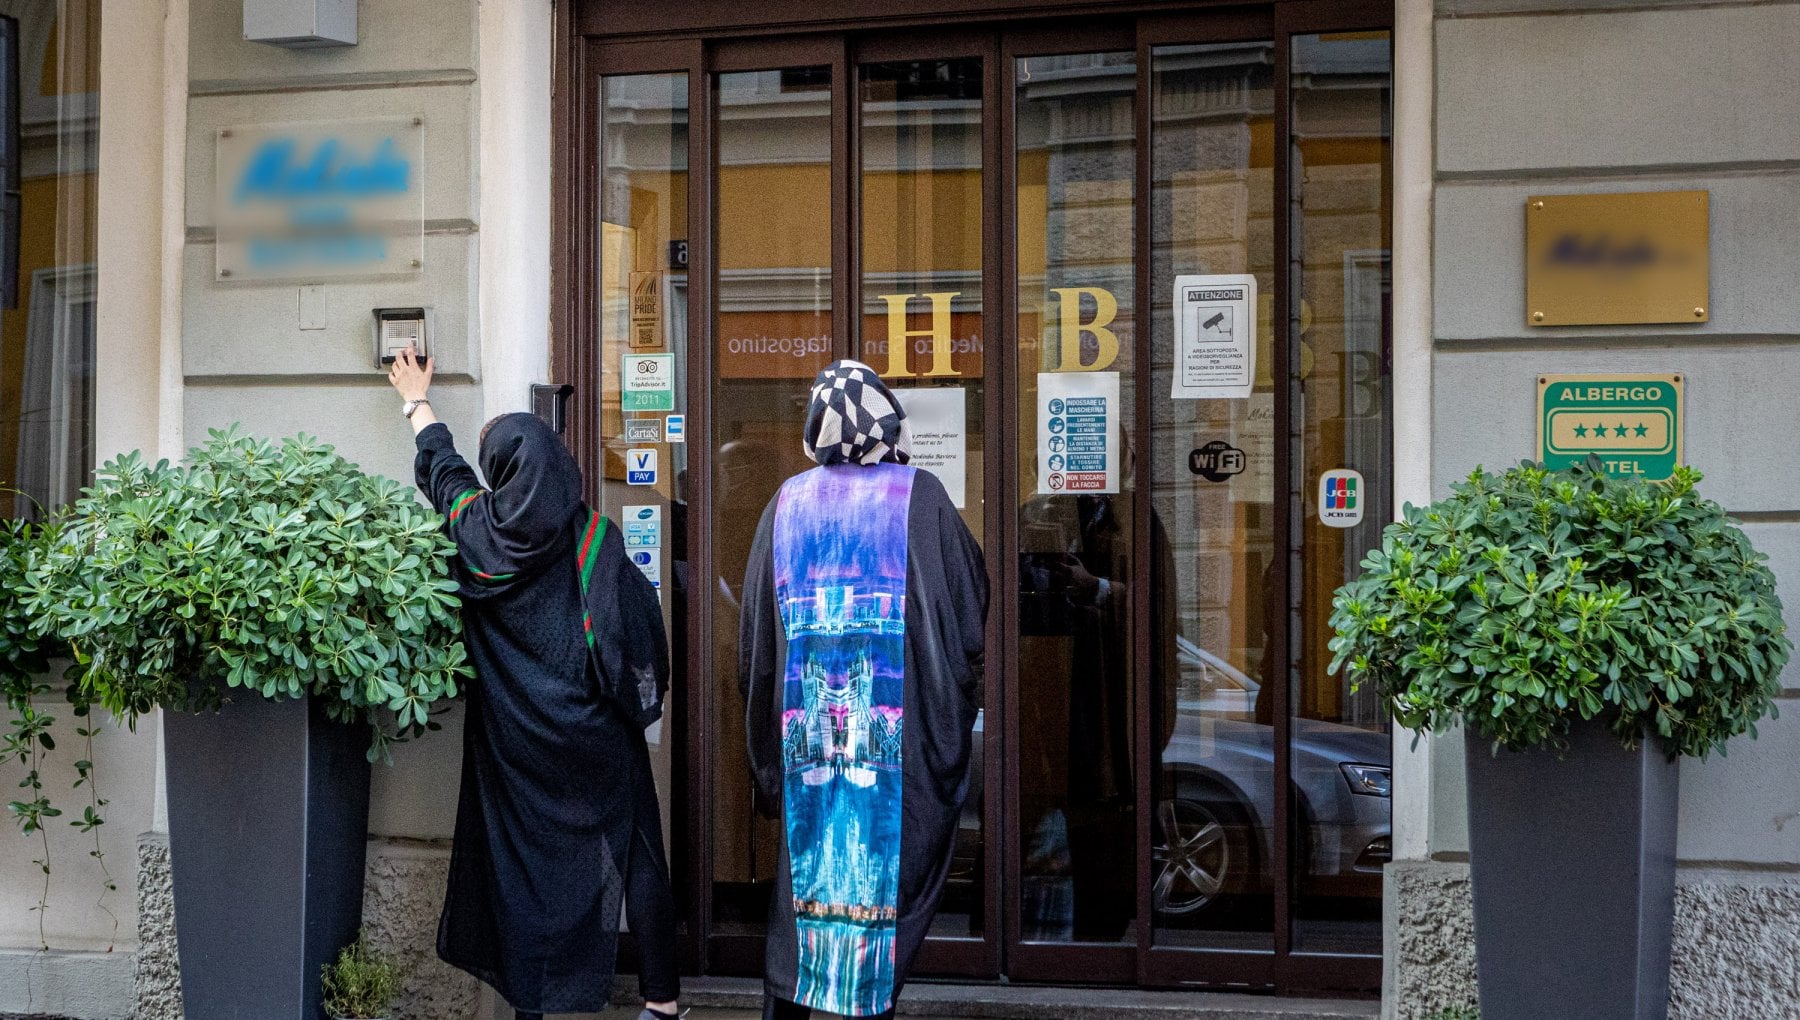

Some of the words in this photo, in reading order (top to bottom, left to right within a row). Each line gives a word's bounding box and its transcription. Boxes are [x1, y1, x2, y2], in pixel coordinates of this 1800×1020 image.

[1188, 290, 1242, 300] ATTENZIONE
[635, 304, 656, 314] PRIDE
[878, 292, 962, 378] H
[1050, 287, 1119, 372] B
[635, 394, 659, 405] 2011
[1560, 387, 1662, 401] ALBERGO
[636, 454, 649, 469] V
[634, 472, 650, 481] PAY
